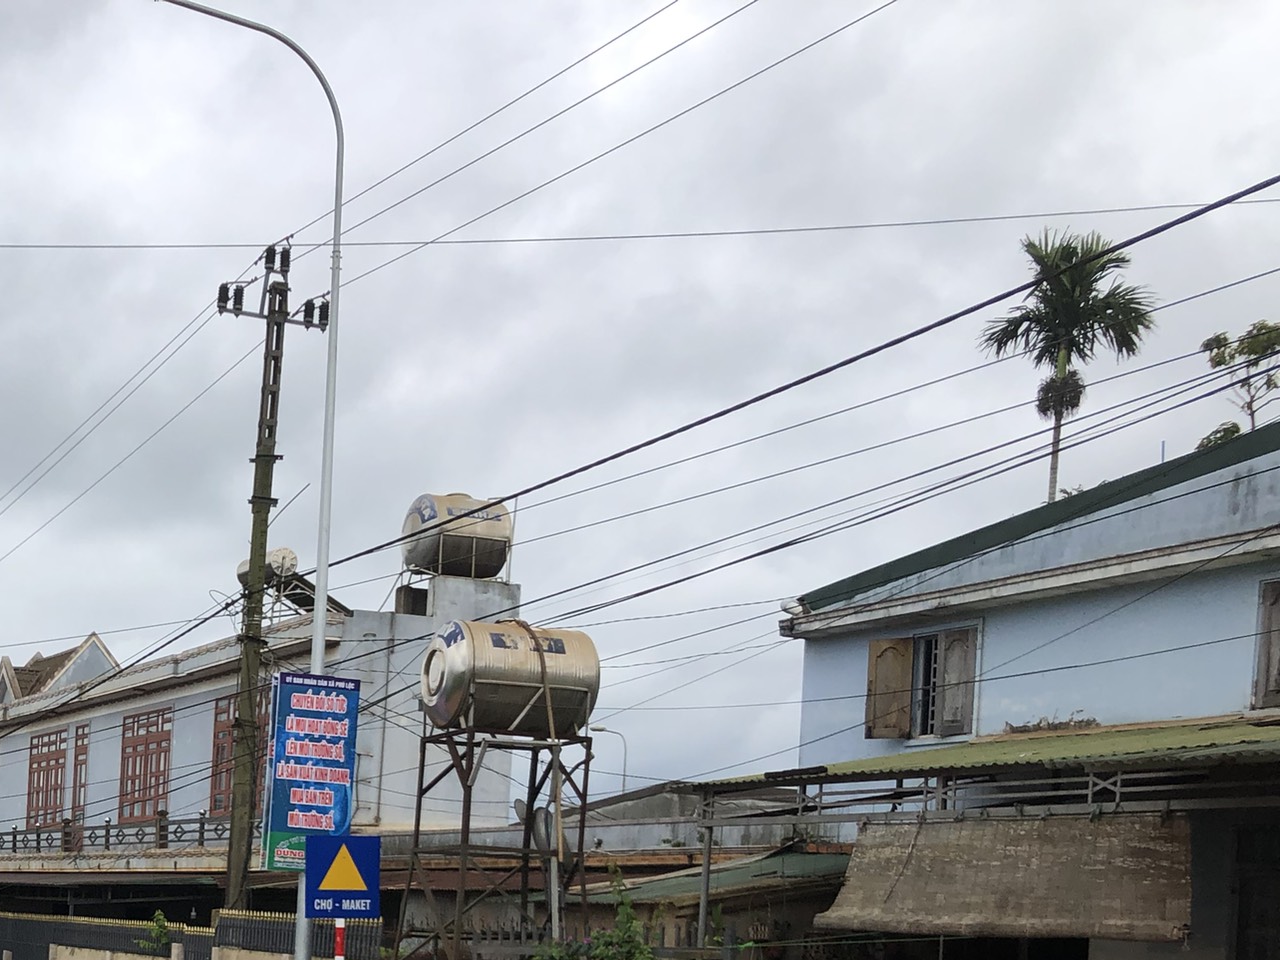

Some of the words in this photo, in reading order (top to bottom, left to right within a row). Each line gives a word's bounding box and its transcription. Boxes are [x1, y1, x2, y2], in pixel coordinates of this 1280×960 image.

[314, 765, 328, 783] KINH
[290, 788, 304, 805] MUA
[314, 898, 333, 912] CHỢ
[342, 899, 371, 910] MAKET
